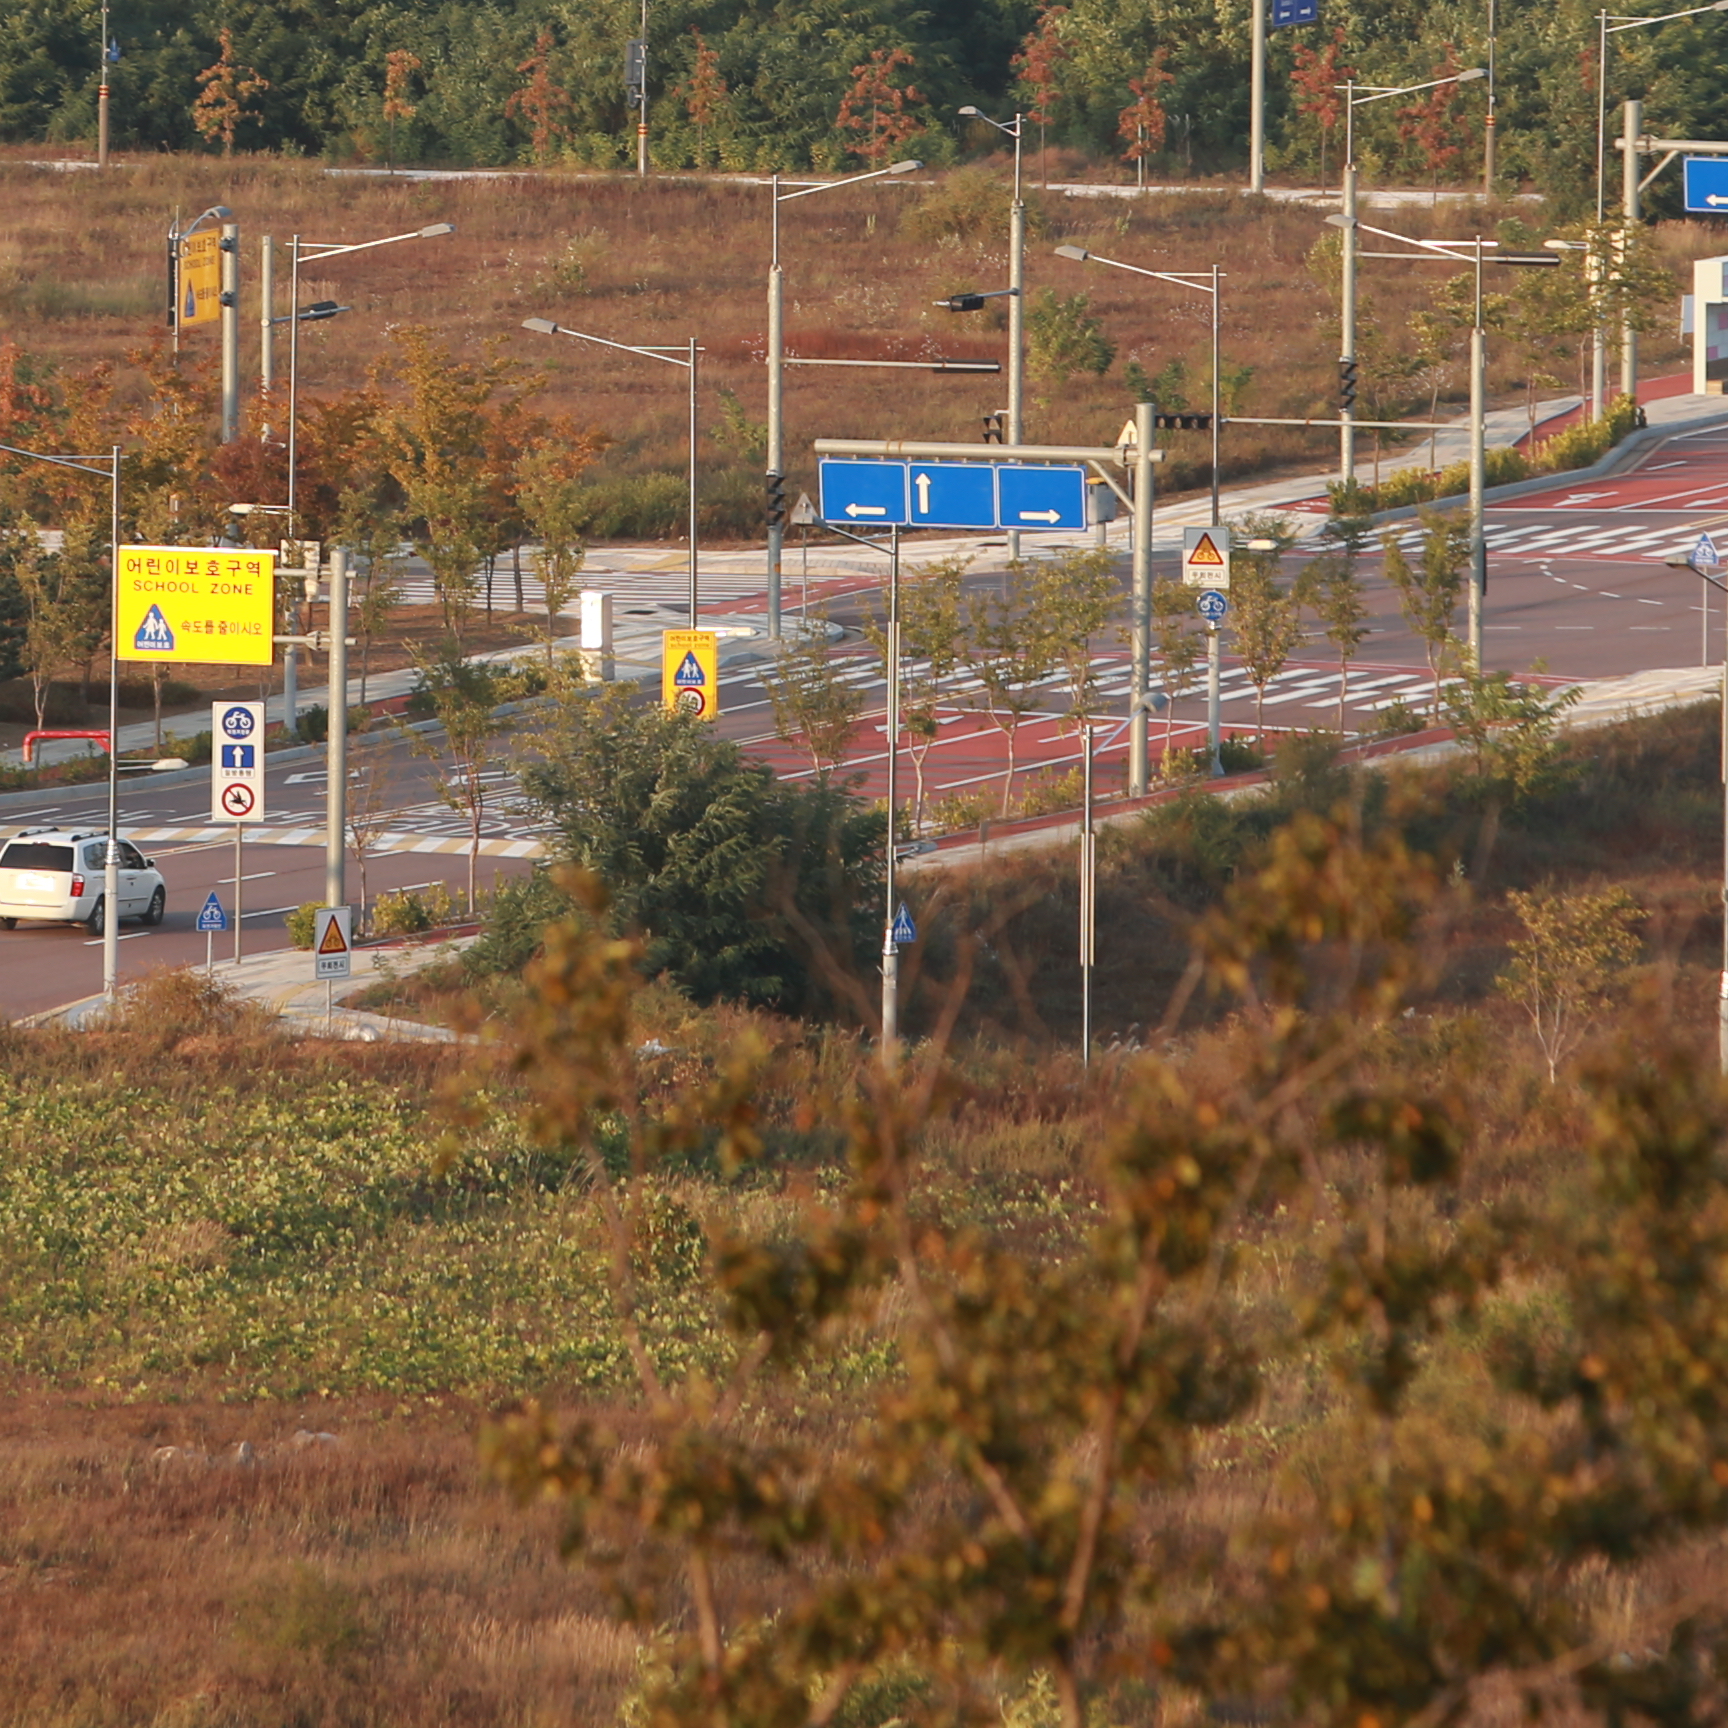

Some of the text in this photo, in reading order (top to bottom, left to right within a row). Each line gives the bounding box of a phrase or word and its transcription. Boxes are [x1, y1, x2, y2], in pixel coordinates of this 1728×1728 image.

[127, 558, 261, 578] 어린이보호구역
[133, 580, 254, 596] SCHOOL ZONE
[180, 620, 263, 636] 속도를 줄이시오
